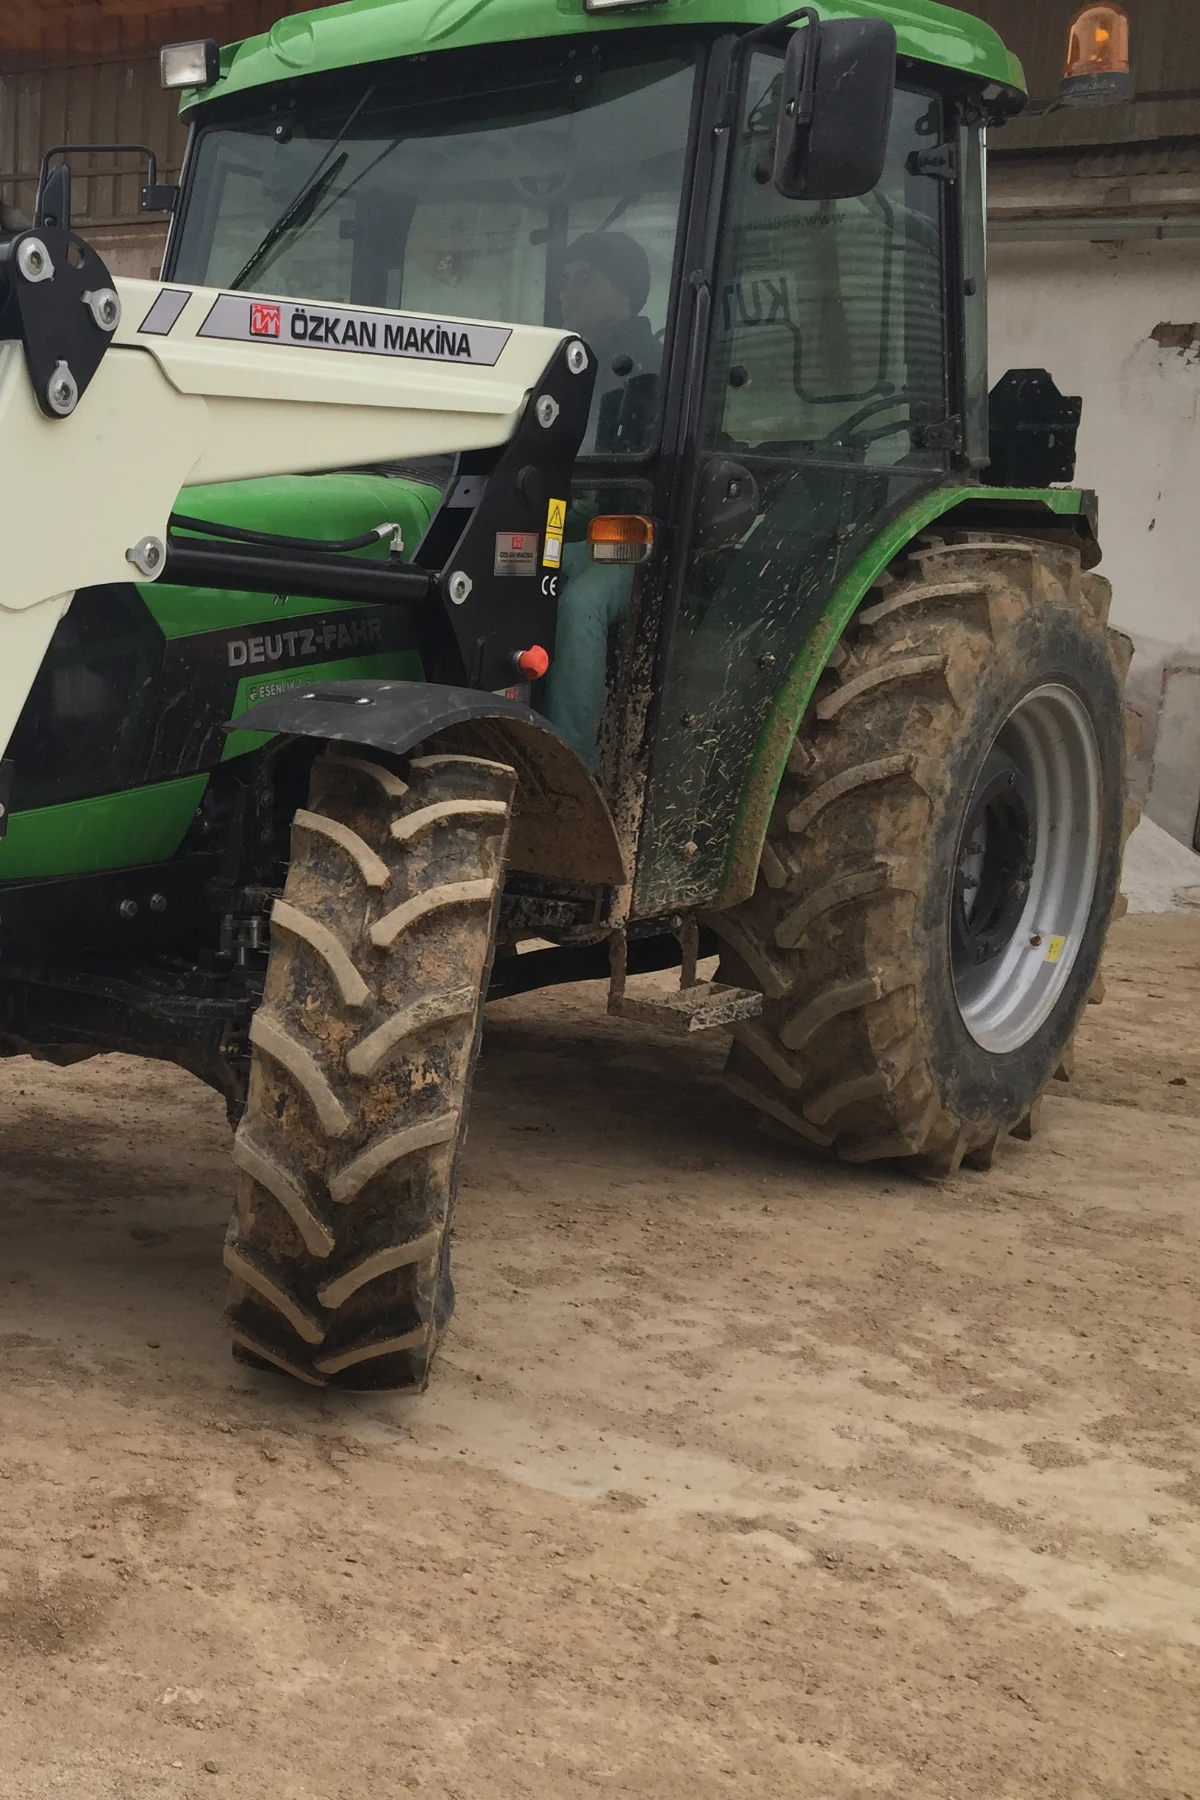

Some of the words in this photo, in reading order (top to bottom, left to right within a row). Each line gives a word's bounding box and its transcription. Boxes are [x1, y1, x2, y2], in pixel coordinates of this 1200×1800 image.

[290, 308, 376, 348] ÖZKAN
[384, 324, 472, 358] MAKİNA
[541, 575, 558, 596] CE
[227, 617, 383, 668] DEUTZ-FAHR
